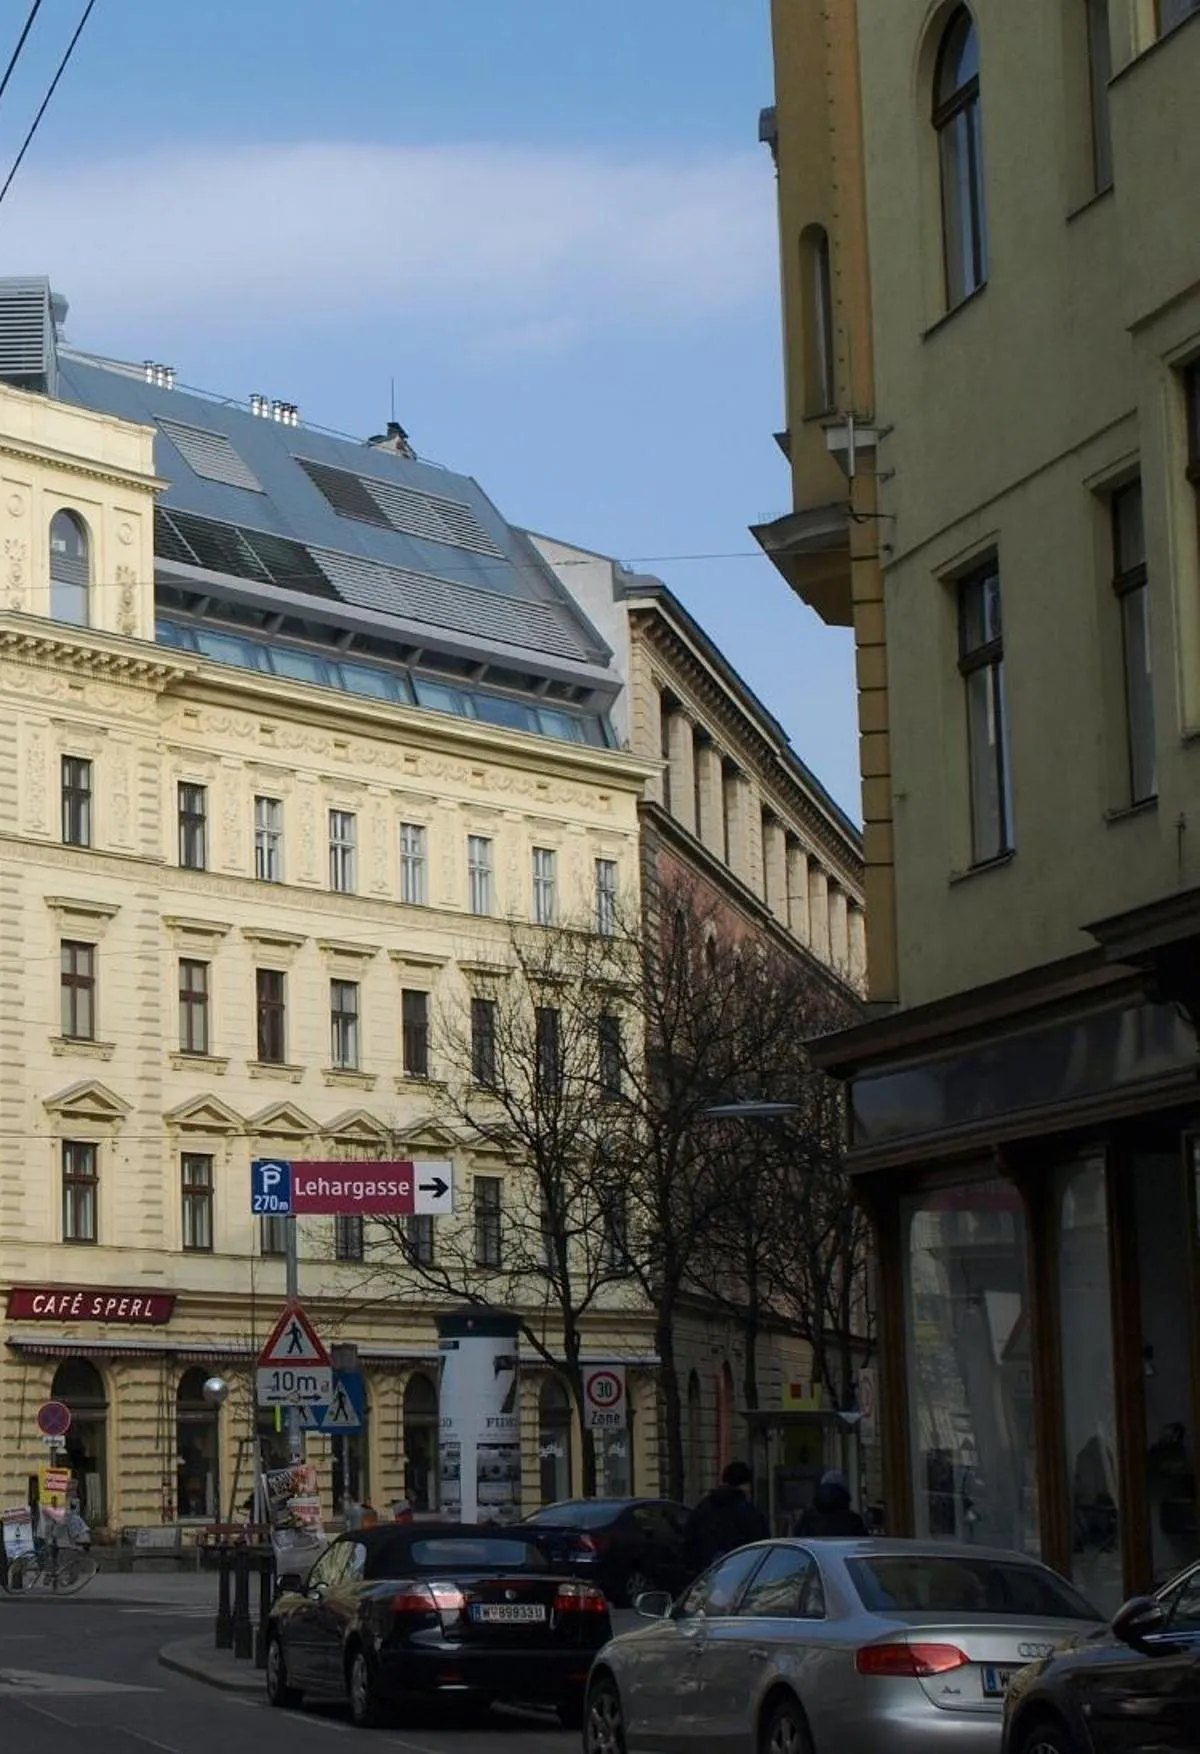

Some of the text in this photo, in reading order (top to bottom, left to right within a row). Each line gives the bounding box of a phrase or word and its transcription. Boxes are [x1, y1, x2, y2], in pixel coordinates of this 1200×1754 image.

[294, 1177, 410, 1200] Lehargasse
[32, 1292, 153, 1317] CAFÉ SPERL
[595, 1380, 614, 1399] 30
